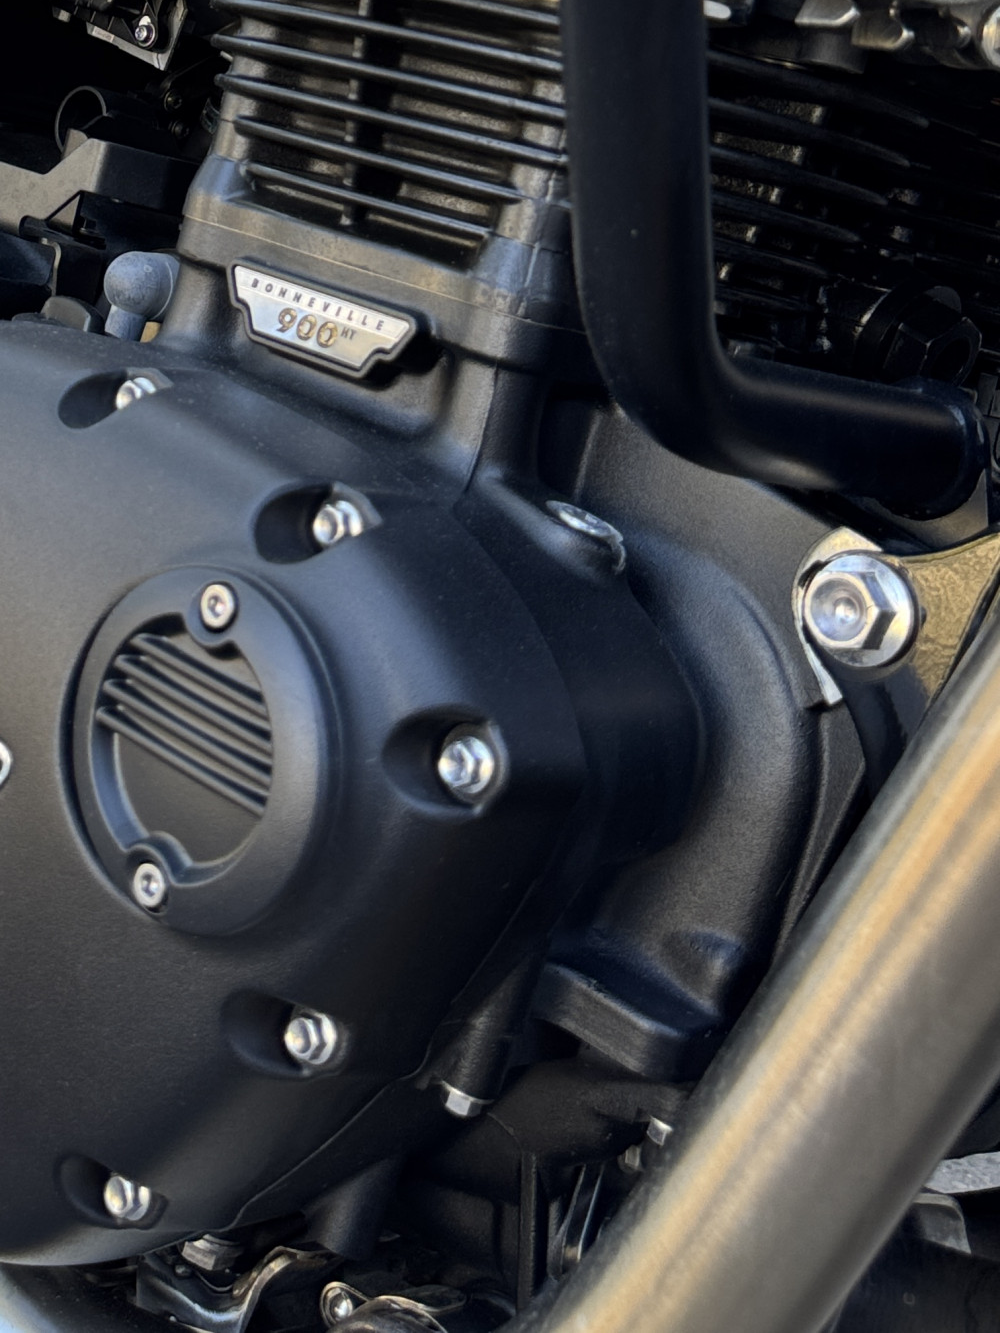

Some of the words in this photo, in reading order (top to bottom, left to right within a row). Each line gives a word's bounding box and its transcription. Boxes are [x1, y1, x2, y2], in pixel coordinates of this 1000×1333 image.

[250, 277, 386, 332] BONNEVILLE
[275, 306, 339, 349] 900
[340, 326, 358, 341] HT
